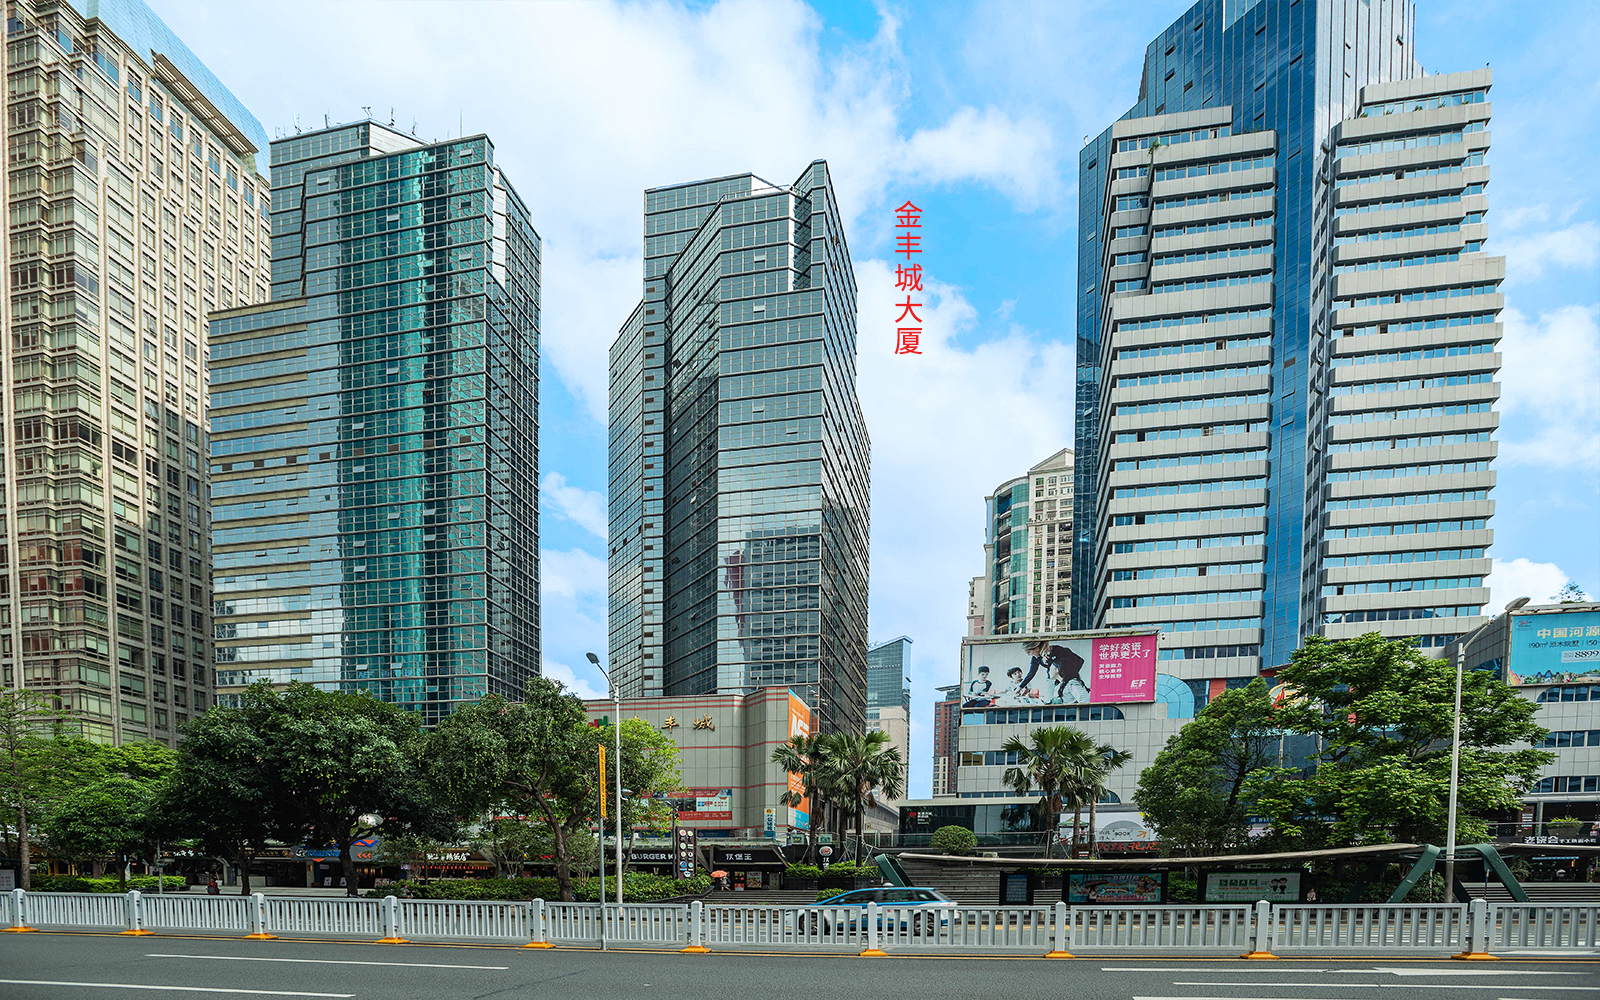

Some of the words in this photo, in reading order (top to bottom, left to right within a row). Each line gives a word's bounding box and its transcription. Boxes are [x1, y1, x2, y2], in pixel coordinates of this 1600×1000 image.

[1537, 625, 1600, 639] 中国河源
[1099, 642, 1141, 652] 学好英语
[1099, 649, 1151, 660] 世界更大了
[1130, 679, 1147, 688] EF
[725, 853, 752, 861] 汉堡王
